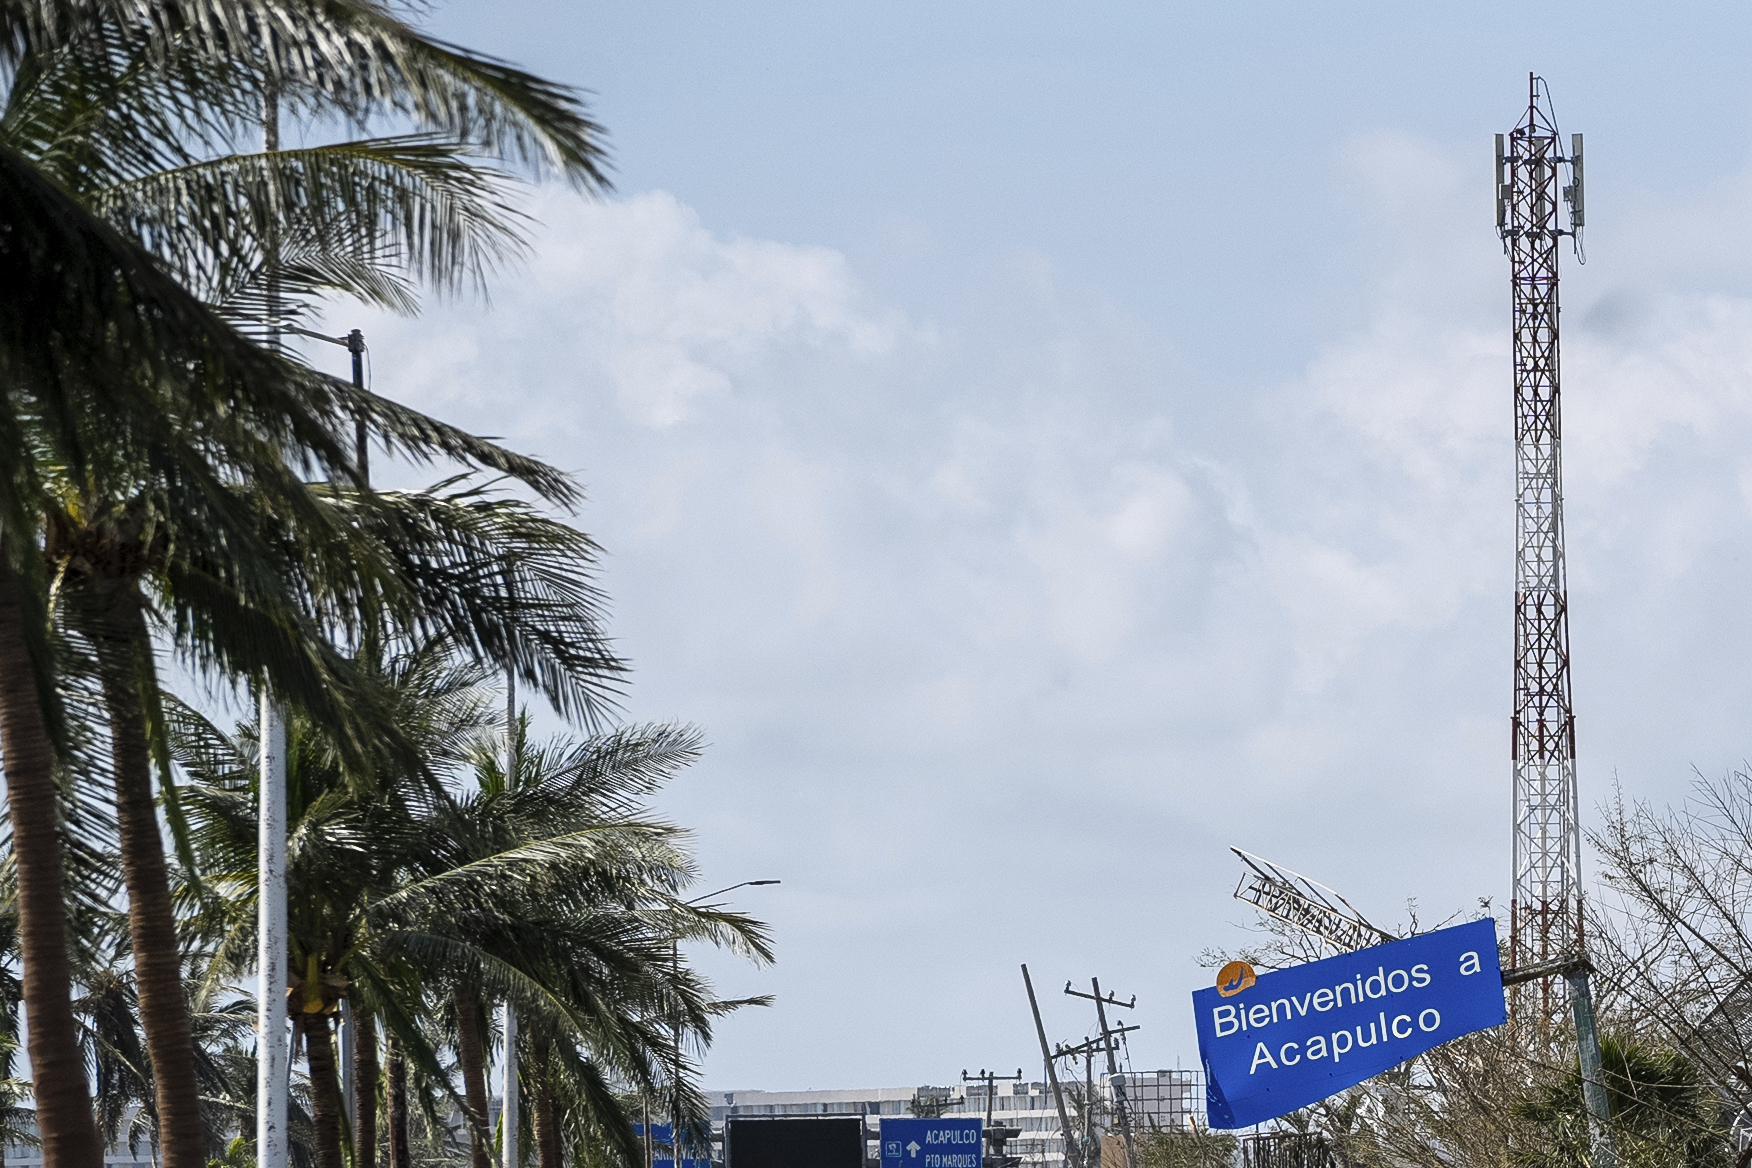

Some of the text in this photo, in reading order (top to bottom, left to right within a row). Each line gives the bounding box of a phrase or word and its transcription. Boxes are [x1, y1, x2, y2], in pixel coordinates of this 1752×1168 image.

[1212, 951, 1482, 1038] Bienvenidos a
[1249, 1007, 1441, 1076] Acapulco
[925, 1130, 977, 1145] ACAPULCO
[925, 1154, 977, 1168] PTO MARQUES
